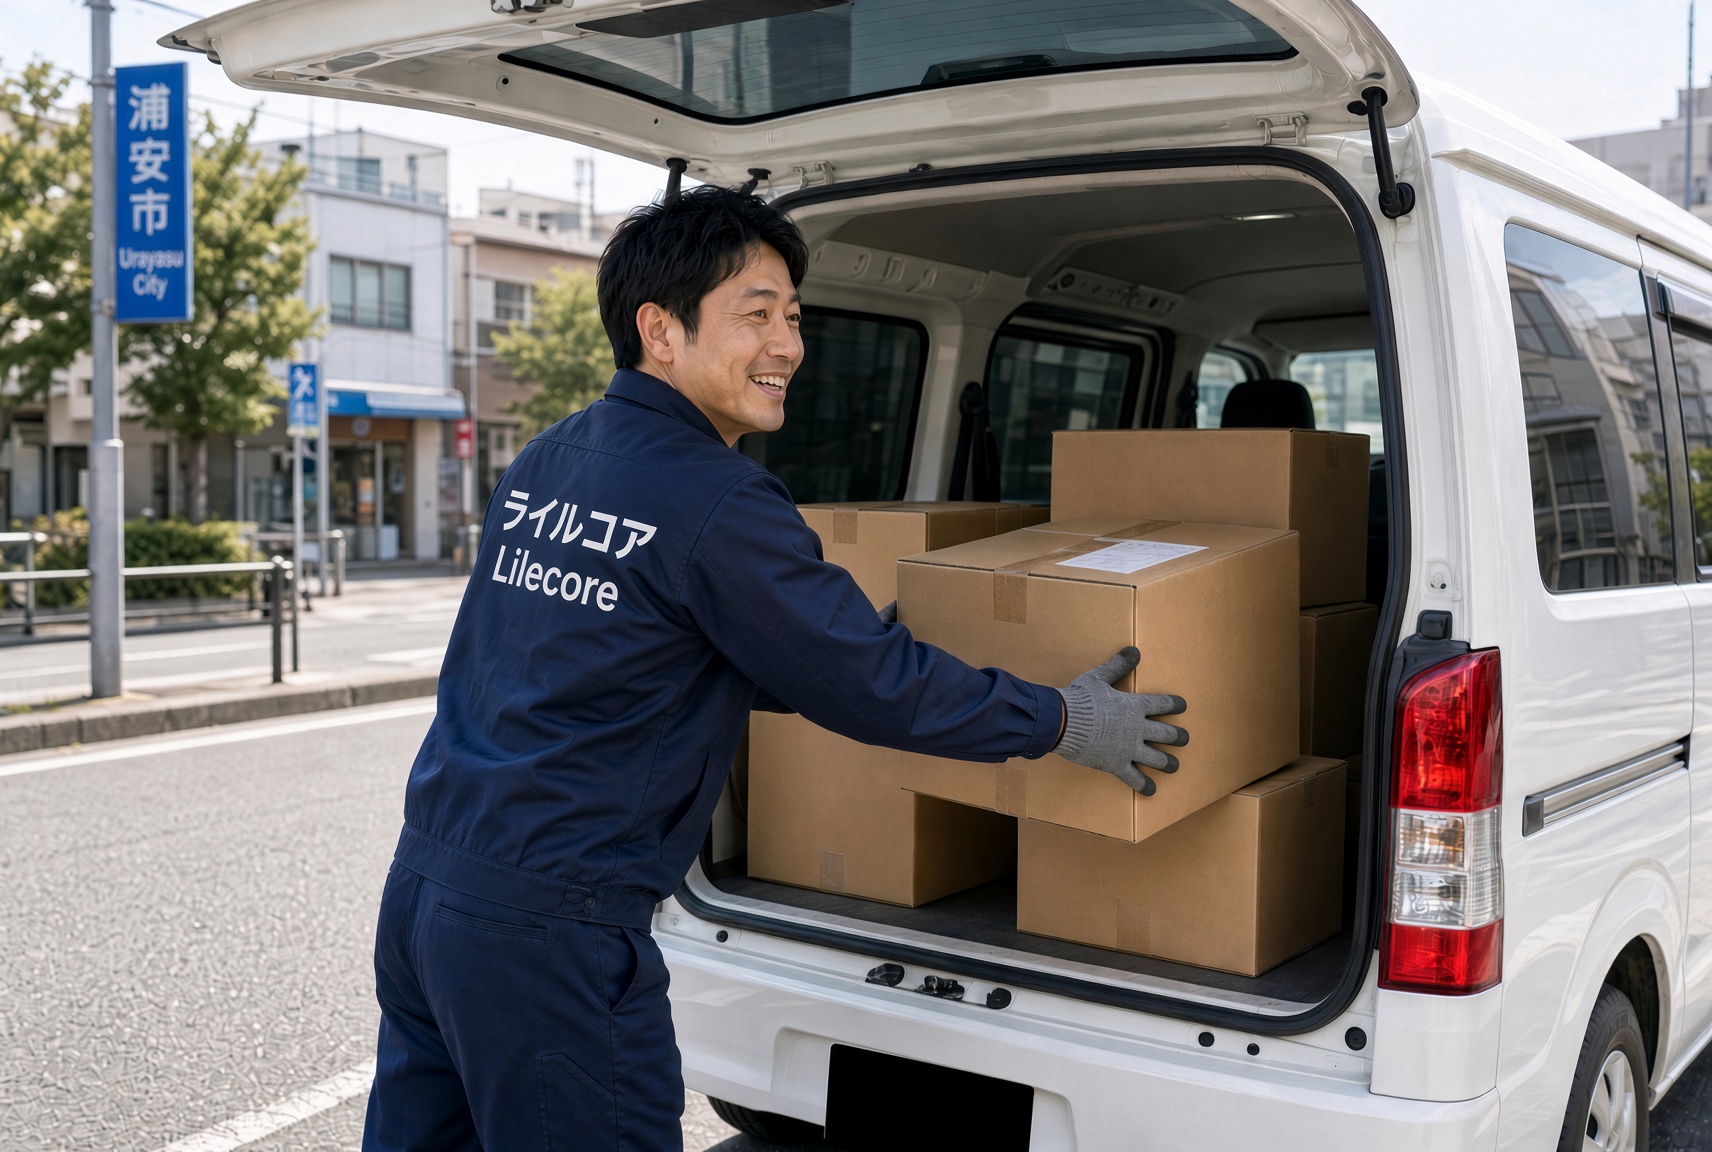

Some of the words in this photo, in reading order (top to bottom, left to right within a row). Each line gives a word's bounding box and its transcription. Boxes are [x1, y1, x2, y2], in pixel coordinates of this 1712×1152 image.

[128, 82, 171, 236] 浦安市
[119, 247, 184, 273] Urayasu
[132, 273, 169, 301] City
[503, 489, 657, 560] ライルコア
[492, 544, 619, 612] Lilecore
